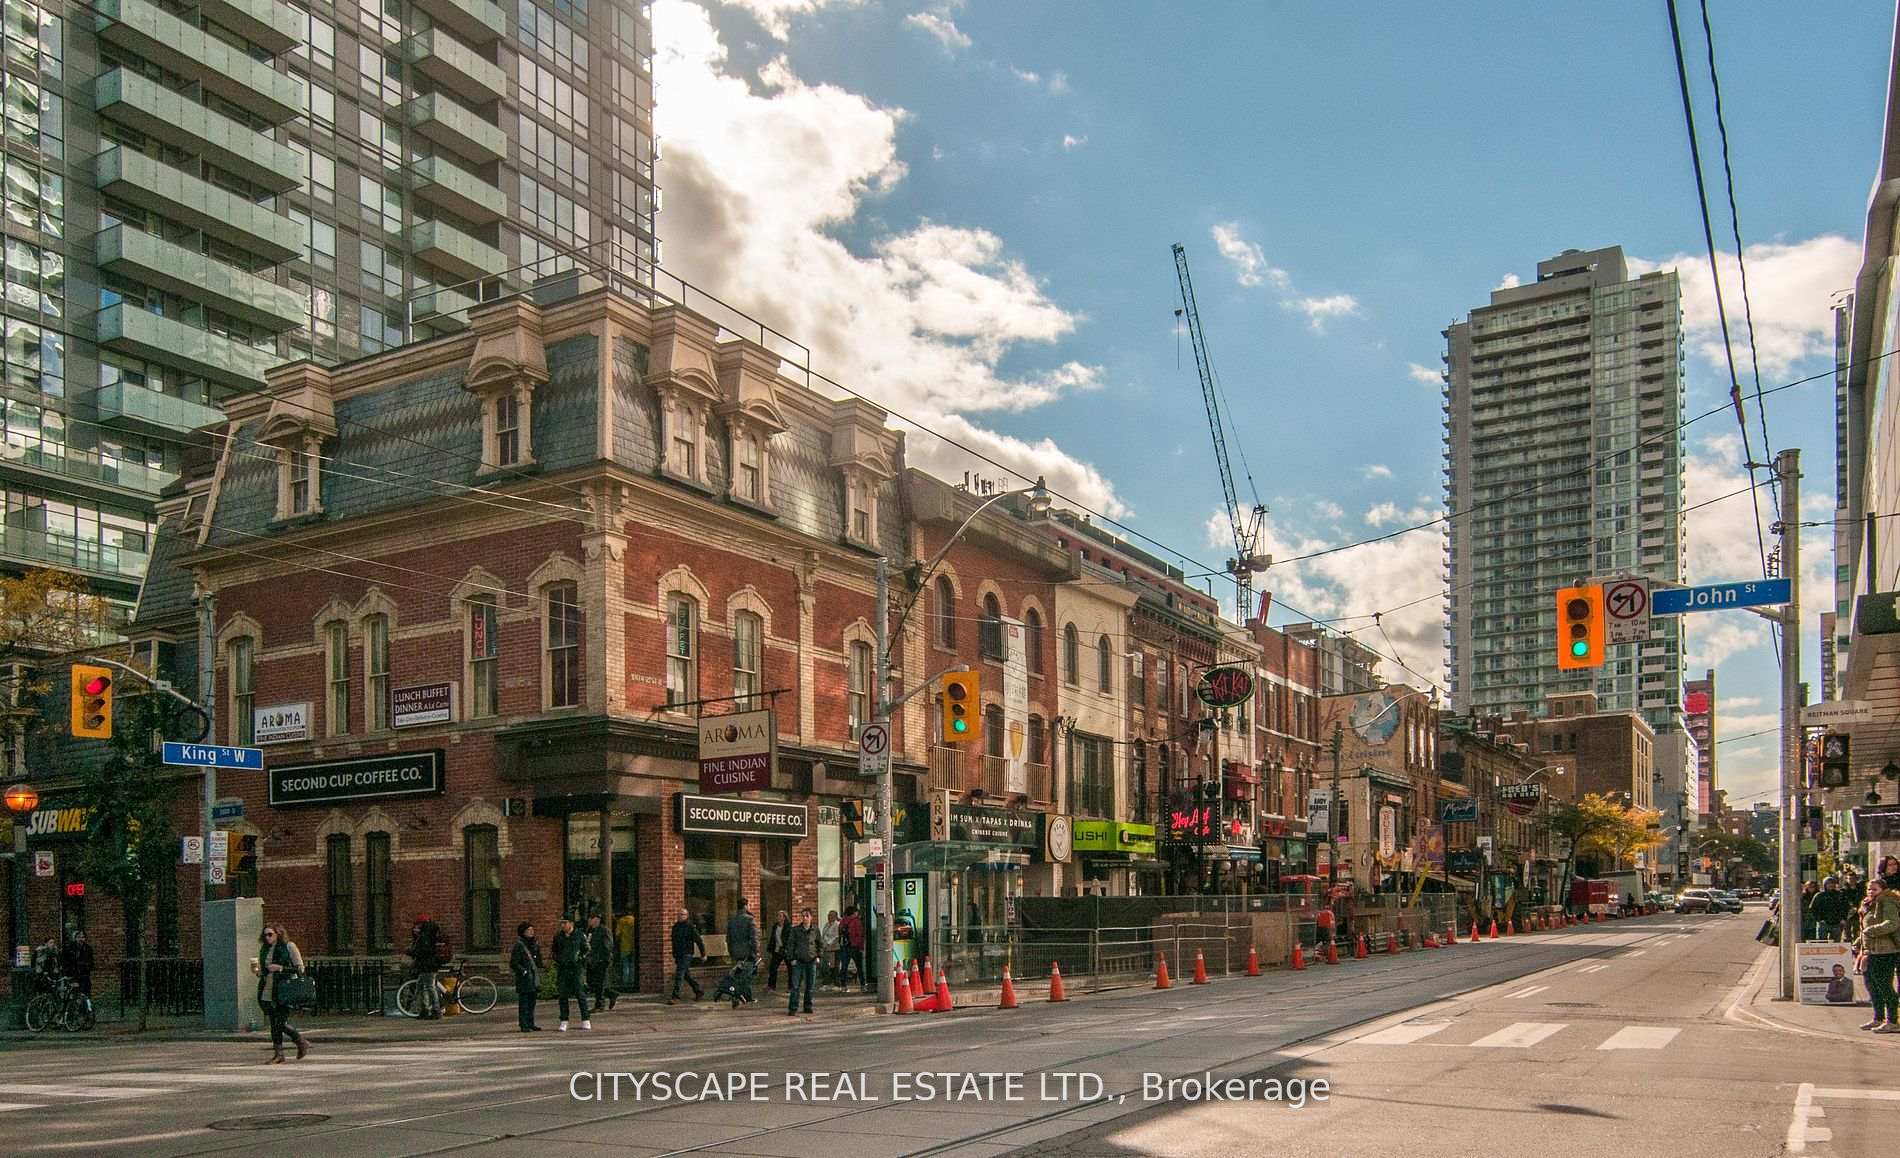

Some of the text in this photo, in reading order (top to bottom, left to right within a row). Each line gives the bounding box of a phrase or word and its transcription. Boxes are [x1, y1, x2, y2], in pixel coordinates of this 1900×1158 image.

[1686, 584, 1756, 607] John St
[395, 687, 449, 703] LUNCH BUFFET
[395, 702, 423, 714] DINNER
[1840, 708, 1868, 716] SQUARE
[261, 712, 301, 728] AROMA
[704, 724, 767, 744] AROMA
[182, 746, 246, 764] King St W
[704, 757, 767, 773] FINE INDIAN
[281, 767, 422, 792] SECOND CUP COFFEE CO.
[714, 771, 756, 785] CUISINE
[690, 807, 803, 826] SECOND CUP COFFEE CO.
[934, 794, 945, 841] AROM
[960, 815, 973, 823] SUM
[982, 817, 1002, 826] TAPAS
[1009, 819, 1032, 828] DRINKS
[1074, 831, 1107, 841] USHI
